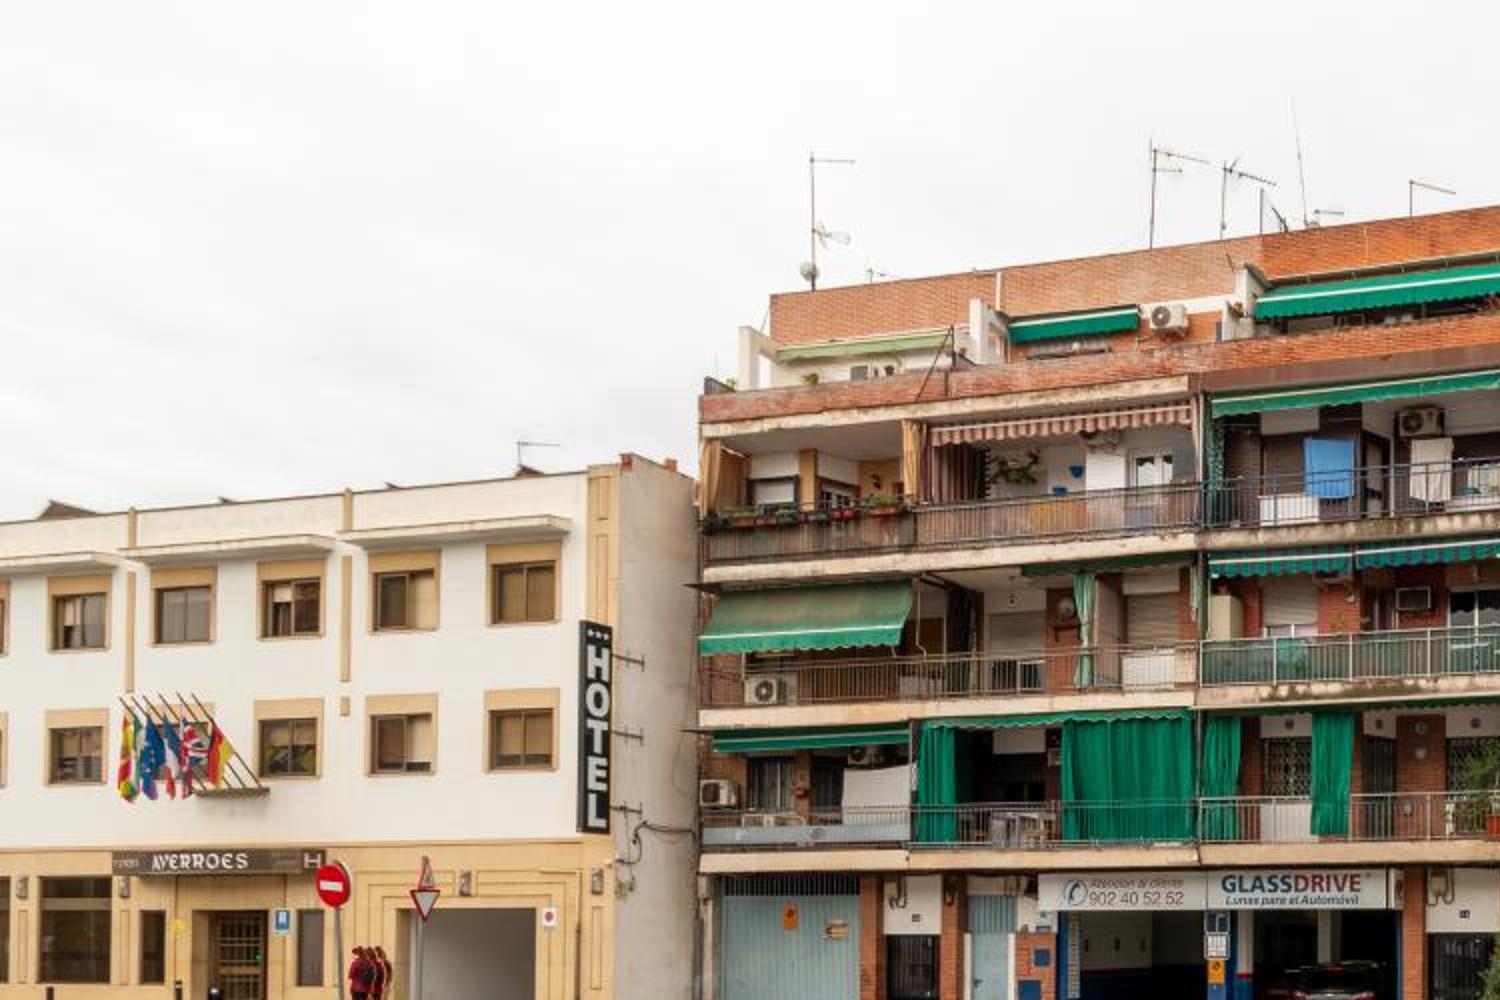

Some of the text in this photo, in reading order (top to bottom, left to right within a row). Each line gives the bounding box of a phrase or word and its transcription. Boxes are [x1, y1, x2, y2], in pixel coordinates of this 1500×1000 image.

[586, 644, 610, 829] HOTEL
[151, 853, 249, 870] AVERROES
[1221, 873, 1362, 894] GLASSDRIVE
[1089, 891, 1185, 906] 902 40 52 52
